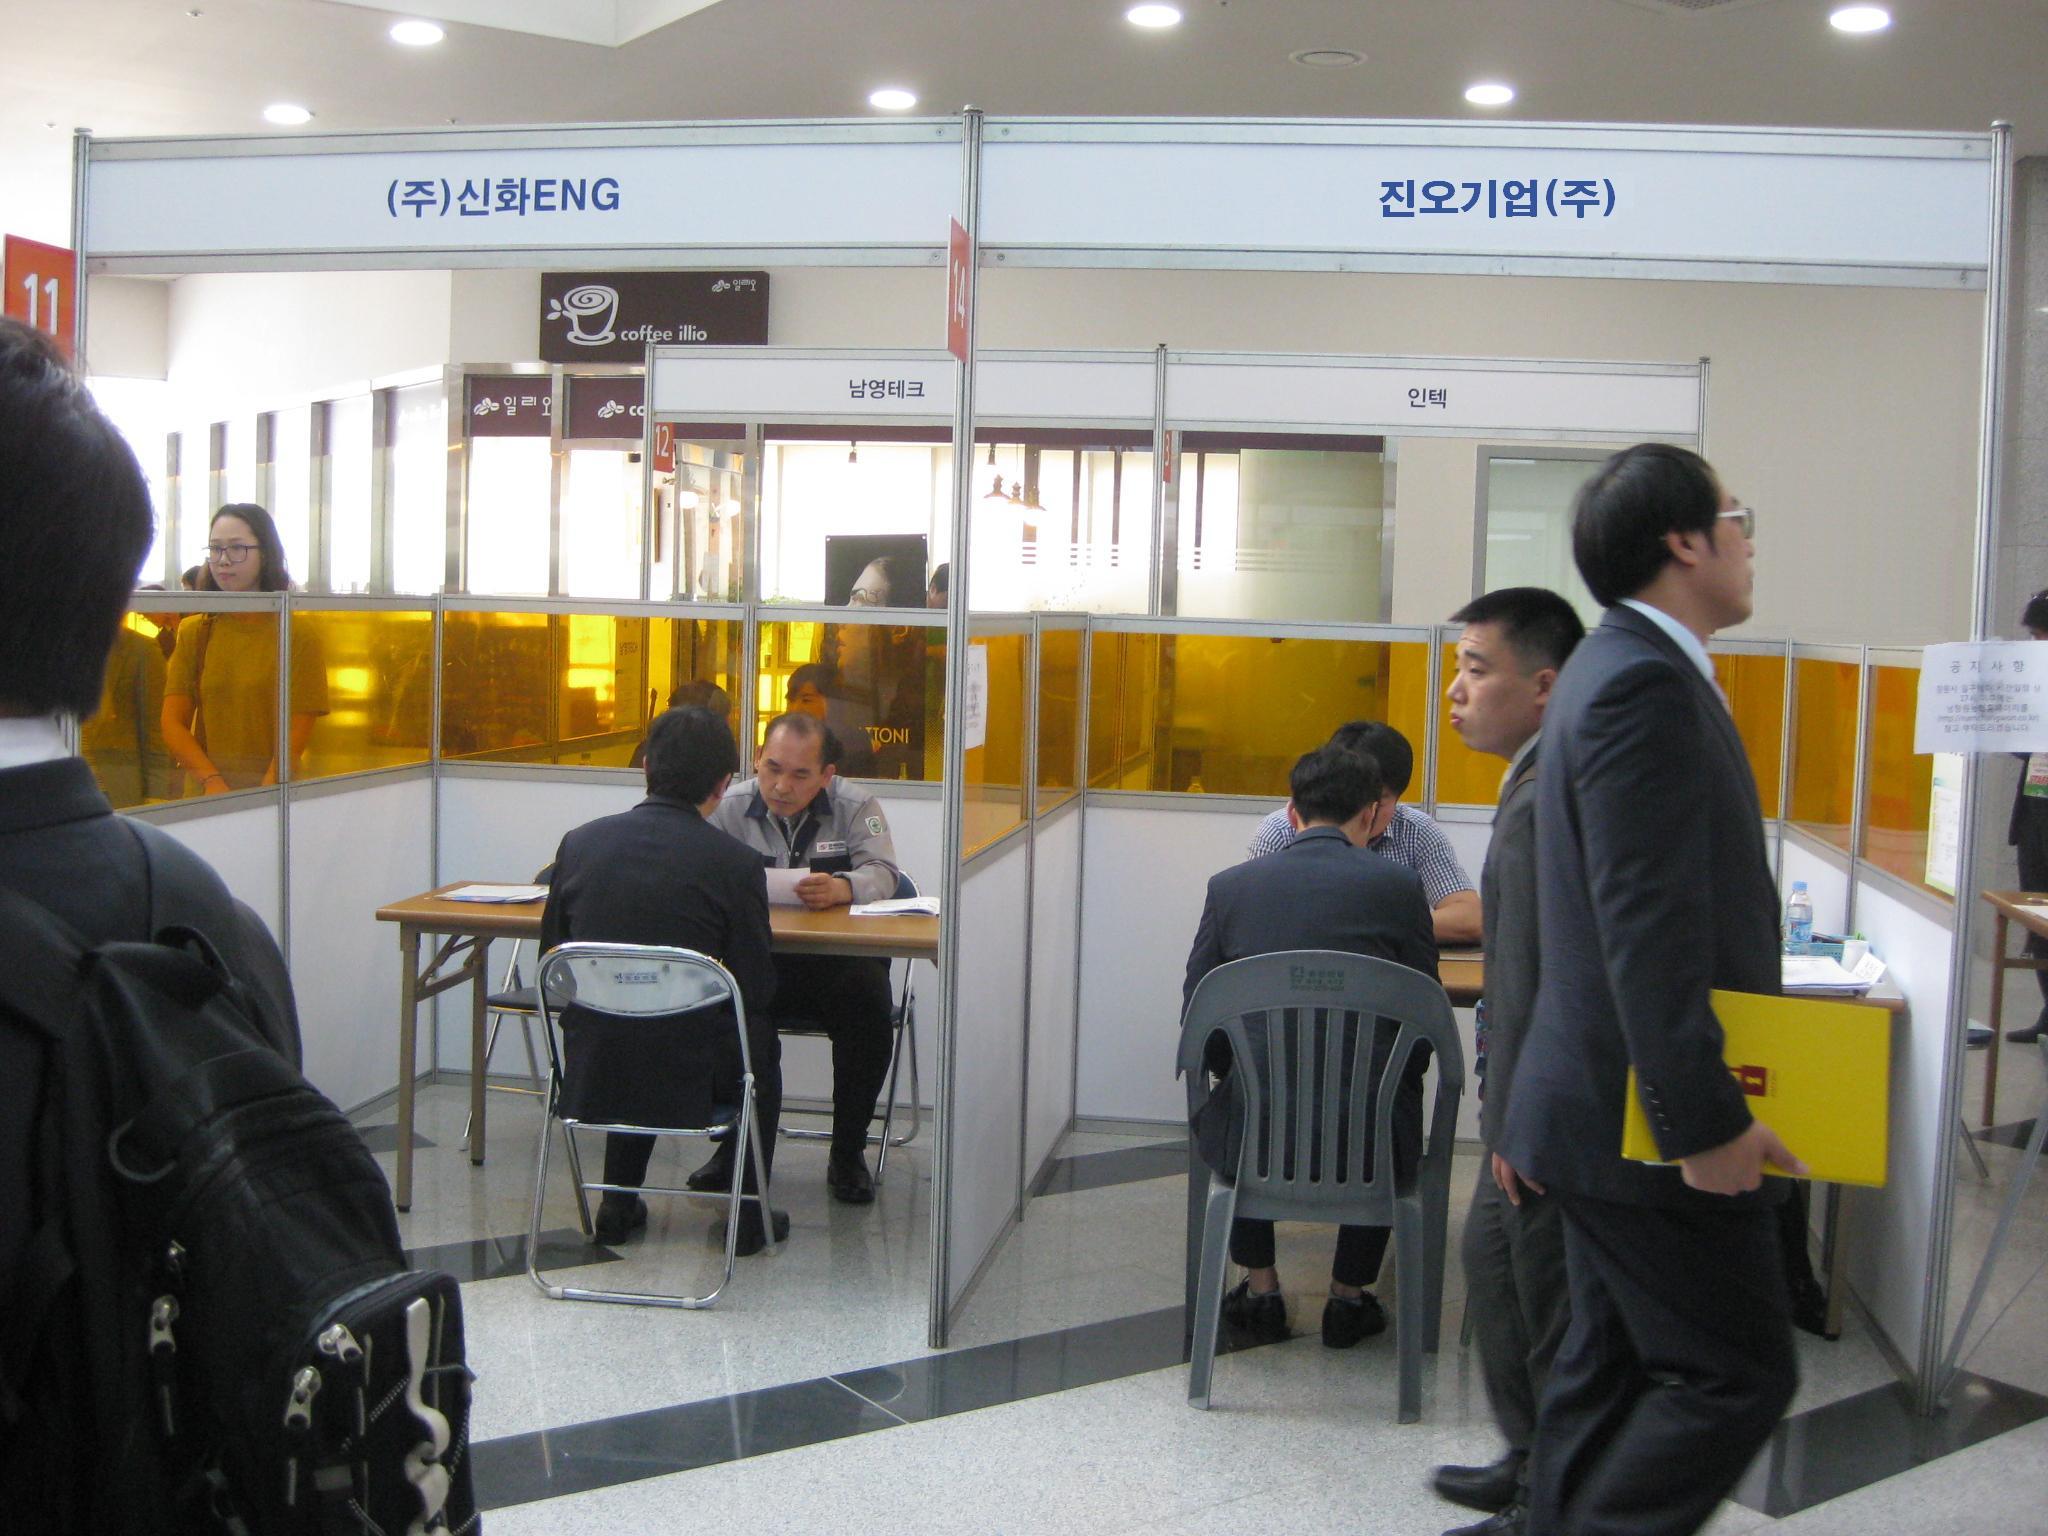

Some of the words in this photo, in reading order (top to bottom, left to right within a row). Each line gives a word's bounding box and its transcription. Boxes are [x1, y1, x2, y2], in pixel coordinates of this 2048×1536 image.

[387, 178, 620, 218] (주)신화ENG
[1379, 178, 1616, 218] 진오기업(주)
[24, 273, 59, 335] 11
[954, 259, 966, 329] 14
[621, 325, 673, 341] coffee
[679, 325, 708, 341] illio
[849, 379, 925, 399] 남영테크
[1408, 388, 1447, 409] 인텍
[655, 425, 669, 457] 12
